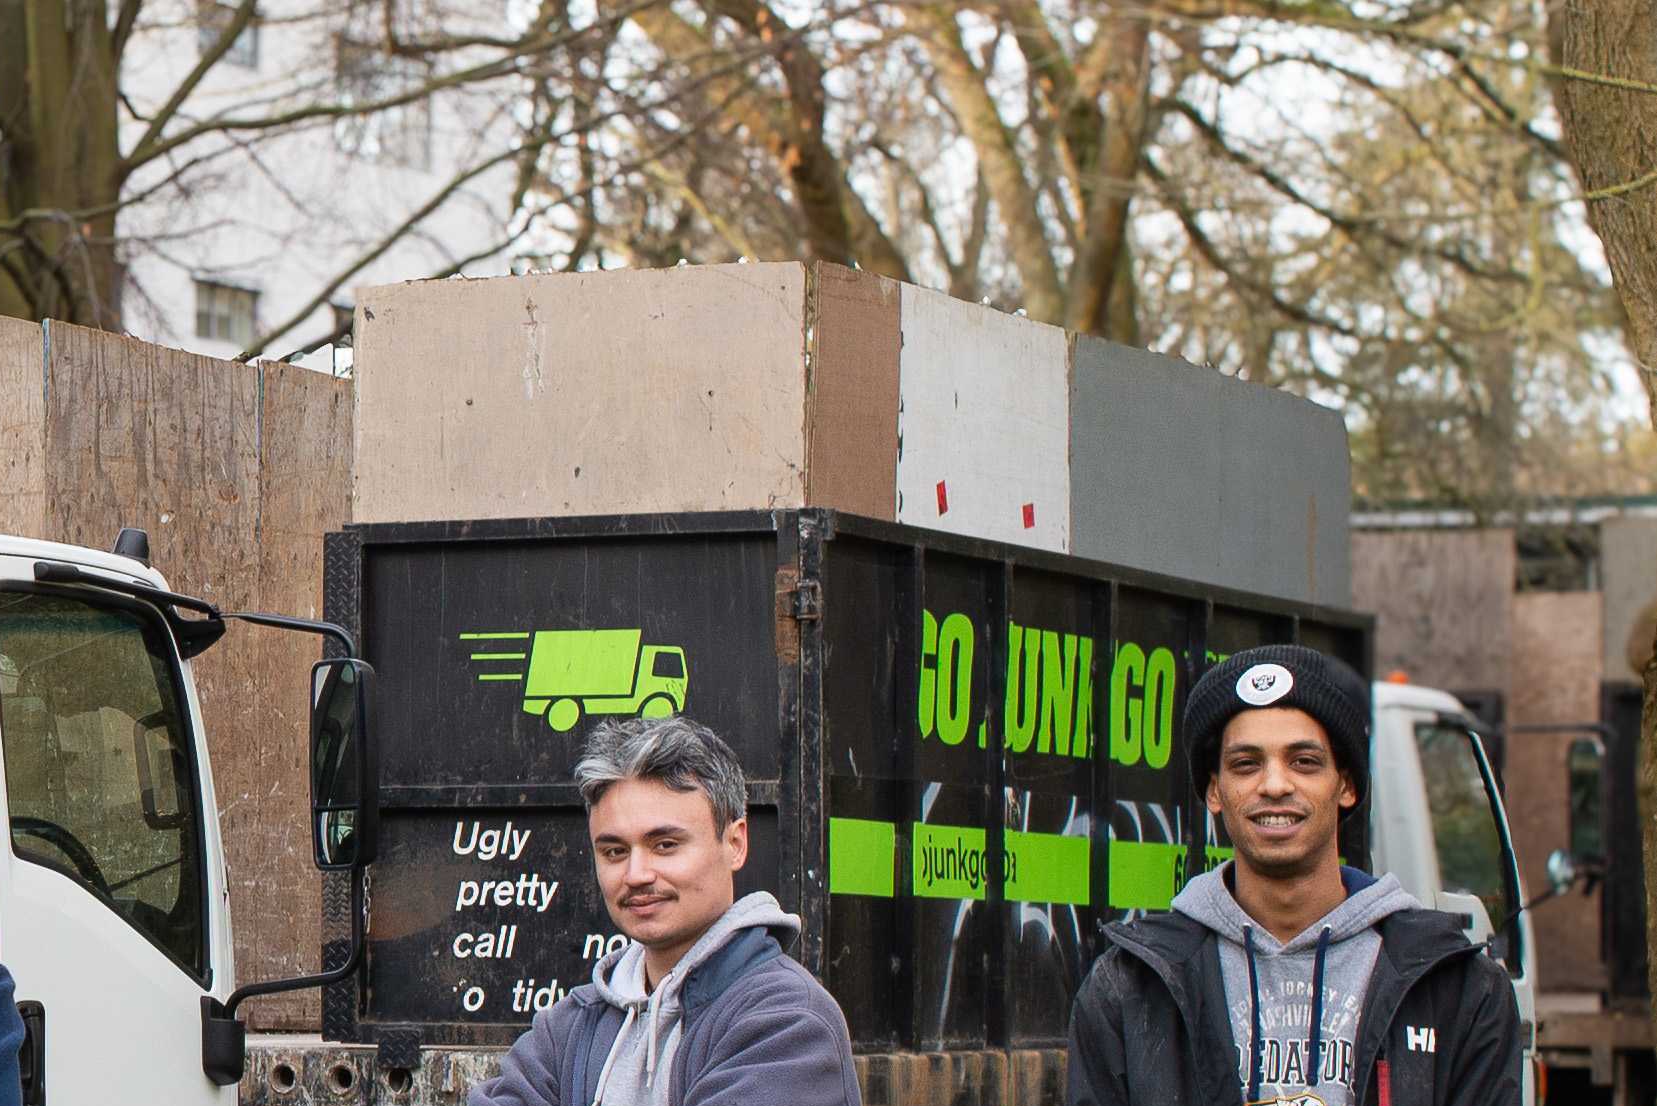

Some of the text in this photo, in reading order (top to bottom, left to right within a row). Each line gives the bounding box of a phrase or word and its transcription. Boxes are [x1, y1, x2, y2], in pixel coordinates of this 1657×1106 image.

[918, 608, 1176, 770] GO UNK GO
[452, 821, 532, 861] Ugly
[455, 873, 559, 912] pretty
[452, 925, 633, 960] call no
[453, 978, 485, 1012] o
